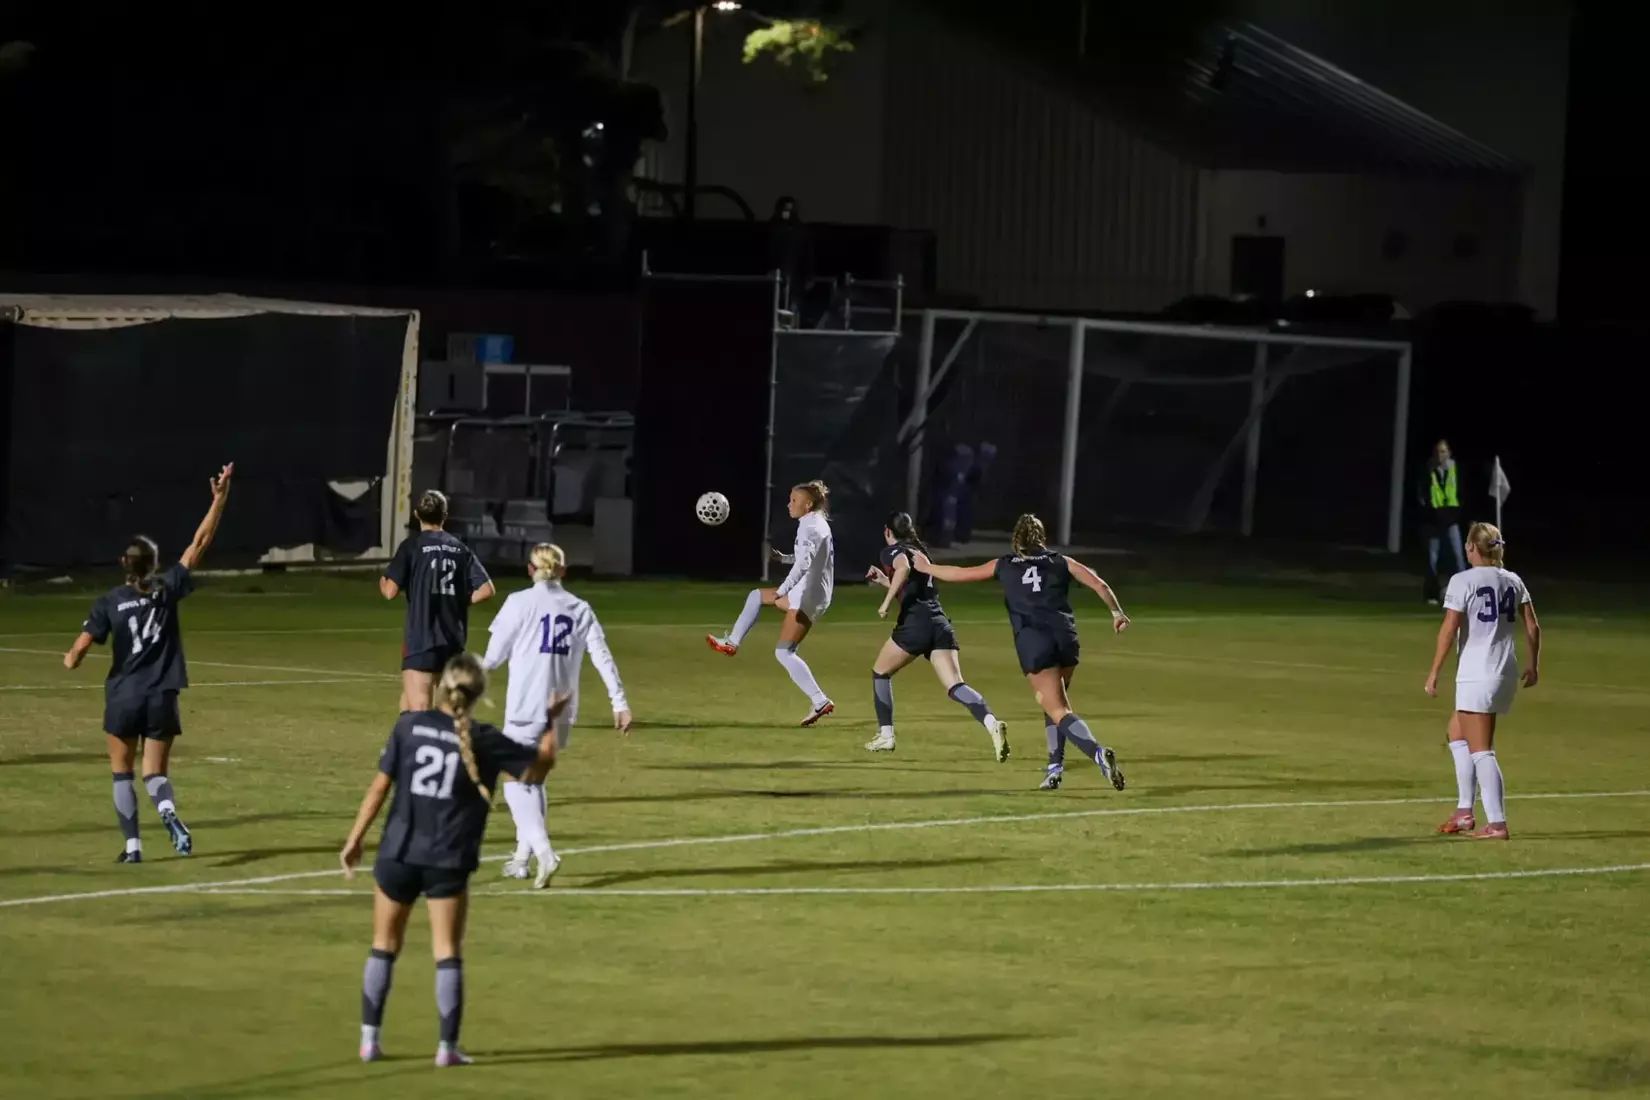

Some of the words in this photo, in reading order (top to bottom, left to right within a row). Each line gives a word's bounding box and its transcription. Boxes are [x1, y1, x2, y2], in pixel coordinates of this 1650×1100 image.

[431, 558, 456, 595] 12
[1021, 566, 1041, 592] 4
[1476, 586, 1515, 622] 34
[128, 607, 161, 654] 14
[539, 613, 573, 655] 12
[410, 745, 459, 799] 21
